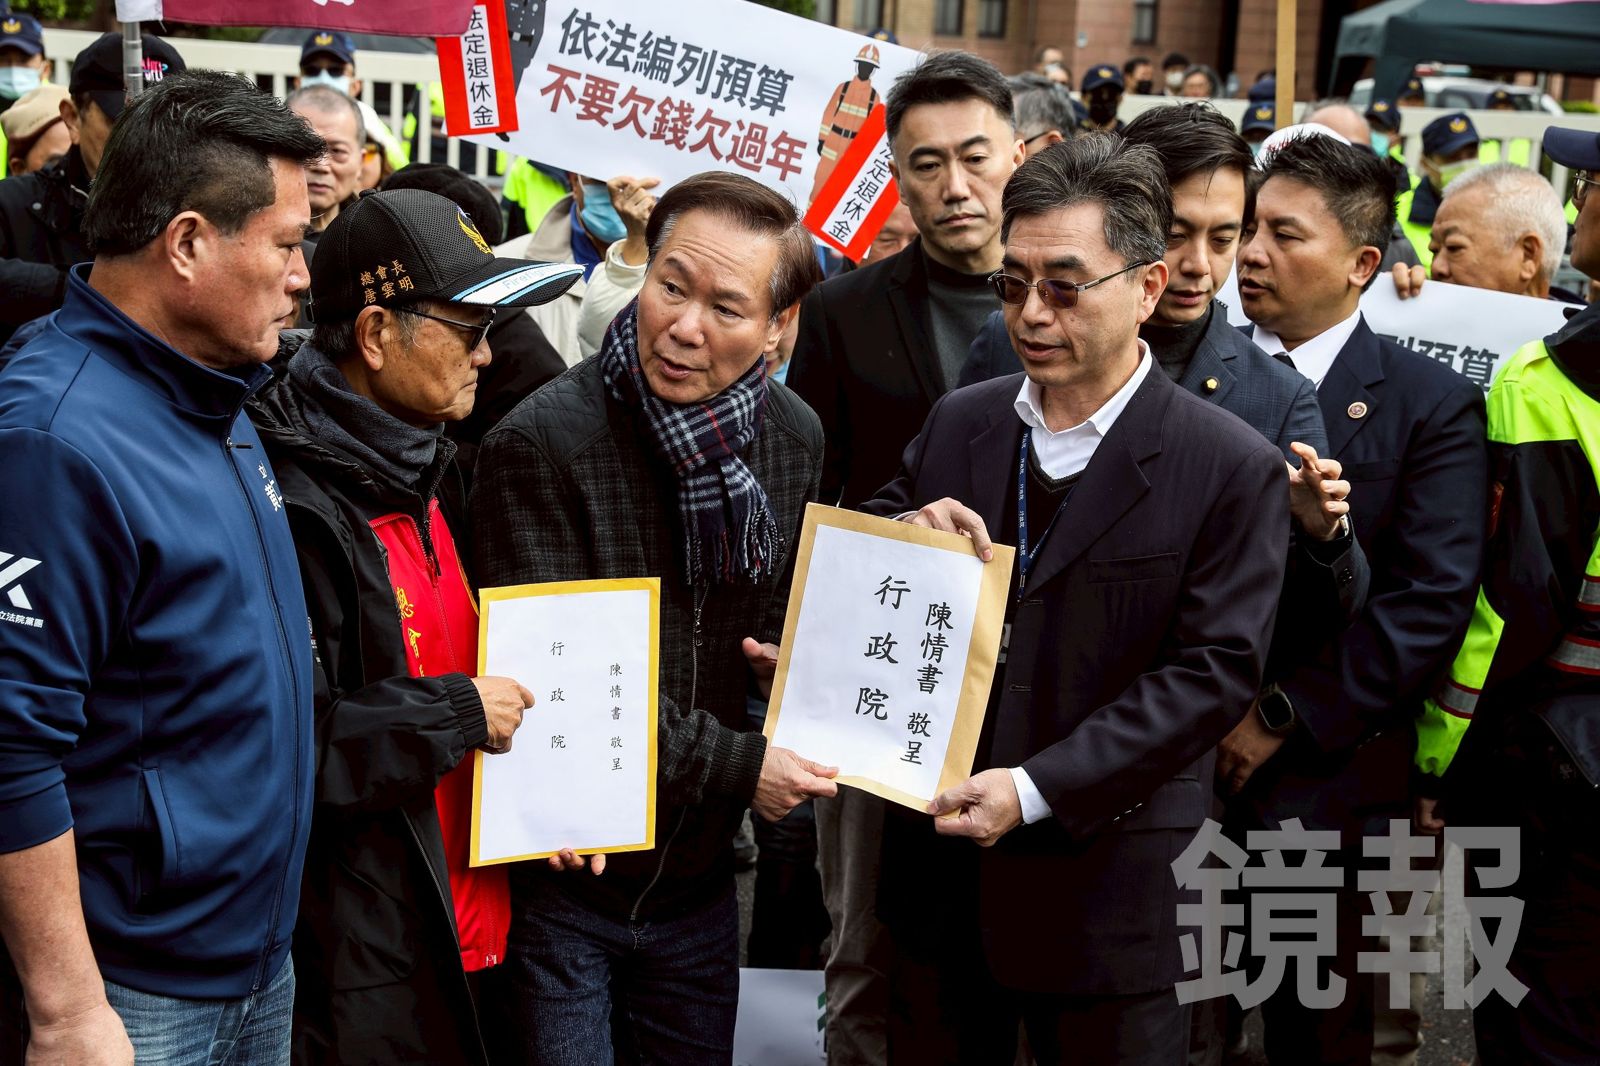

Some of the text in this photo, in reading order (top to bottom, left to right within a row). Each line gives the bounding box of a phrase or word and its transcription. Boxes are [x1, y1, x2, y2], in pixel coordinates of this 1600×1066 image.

[558, 8, 794, 117] 依法編列預算
[540, 63, 807, 181] 不要欠錢欠過年
[550, 641, 566, 749] 行政院
[855, 575, 912, 721] 行政院
[900, 601, 954, 765] 陳情書 敬呈
[610, 662, 623, 771] 陳情書 敬呈
